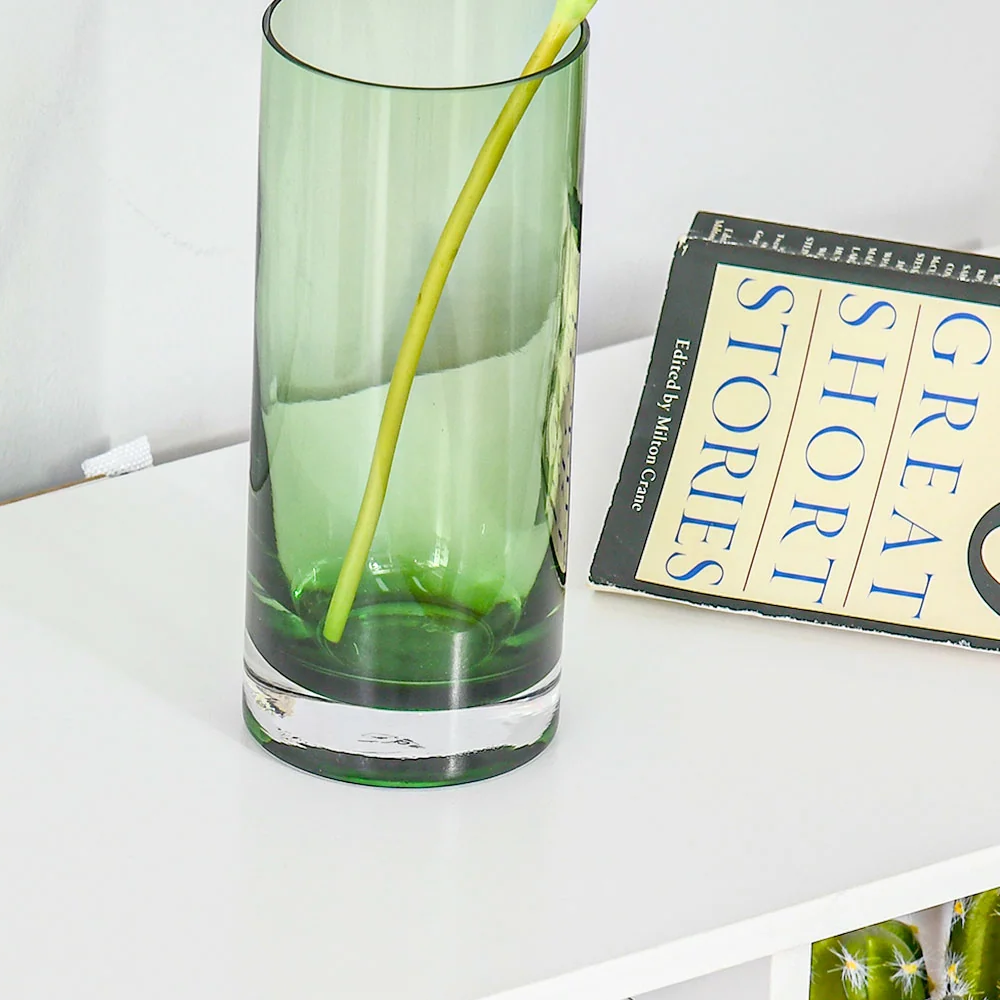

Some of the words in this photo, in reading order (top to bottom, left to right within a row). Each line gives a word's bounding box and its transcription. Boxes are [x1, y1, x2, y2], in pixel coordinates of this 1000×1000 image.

[666, 338, 690, 390] Edited
[657, 393, 679, 411] by
[646, 416, 672, 465] Milton
[665, 277, 795, 586] STORIES
[771, 293, 897, 604] SHORT
[632, 468, 656, 512] Crane
[867, 312, 992, 619] GREAT
